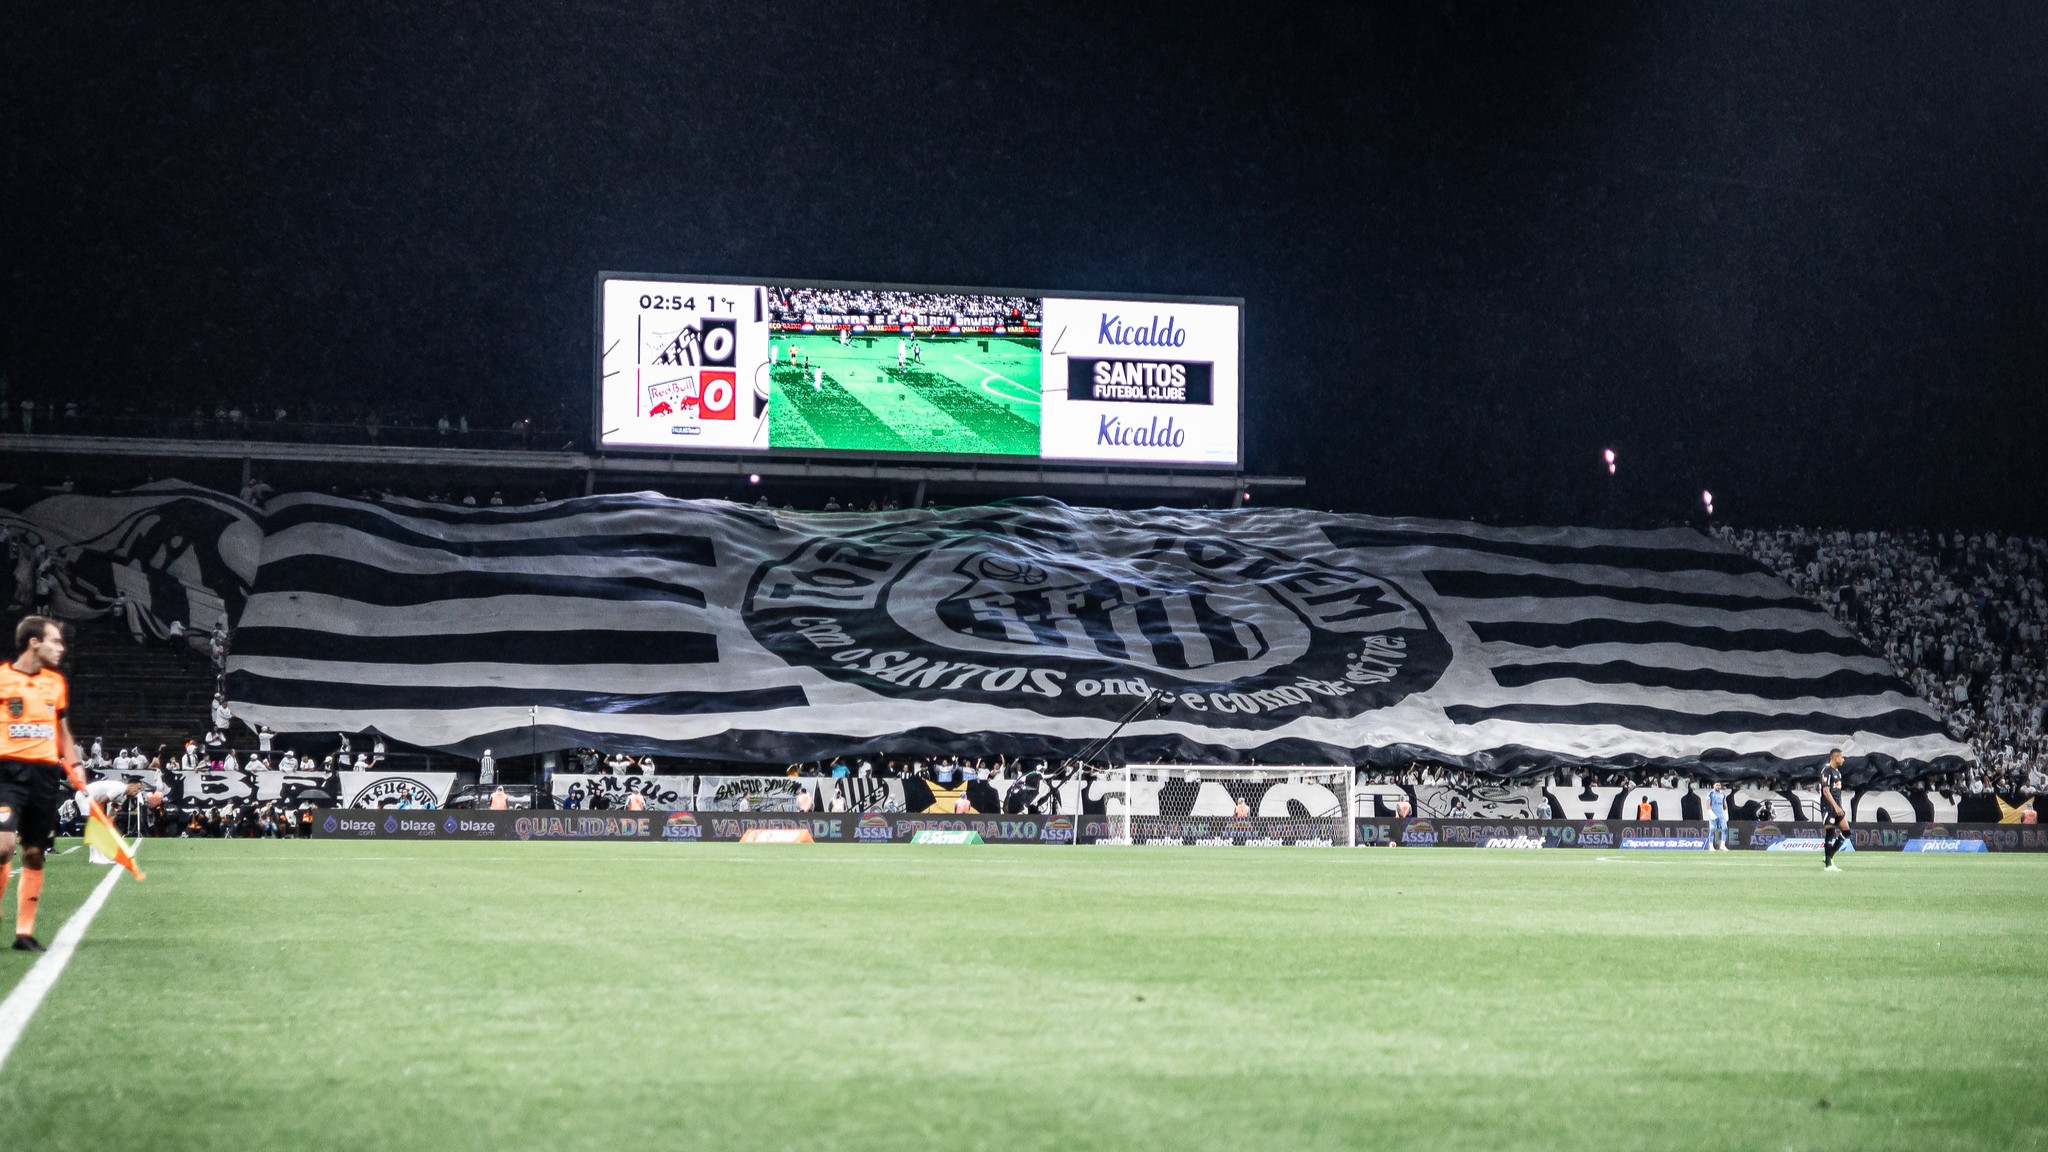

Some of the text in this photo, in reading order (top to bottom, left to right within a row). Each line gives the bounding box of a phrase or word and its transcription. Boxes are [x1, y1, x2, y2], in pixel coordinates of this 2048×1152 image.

[639, 294, 696, 311] 02:54
[1098, 313, 1186, 348] Kicaldo
[703, 327, 734, 362] 0
[1095, 360, 1187, 387] SANTOS
[703, 378, 733, 412] 0
[1095, 384, 1186, 401] FUTEBOL CLUBE
[1097, 414, 1185, 448] Kicaldo
[850, 650, 1067, 697] SANTOS
[1179, 692, 1209, 712] e
[340, 819, 376, 831] blaze
[400, 820, 436, 831] blaze
[460, 820, 496, 832] blaze
[515, 817, 650, 840] QUALIDADE
[1196, 836, 1234, 847] novibet
[1246, 836, 1284, 847] novibet
[1296, 836, 1333, 847] novibet
[1486, 835, 1546, 849] novibet
[1781, 840, 1825, 851] sportingb
